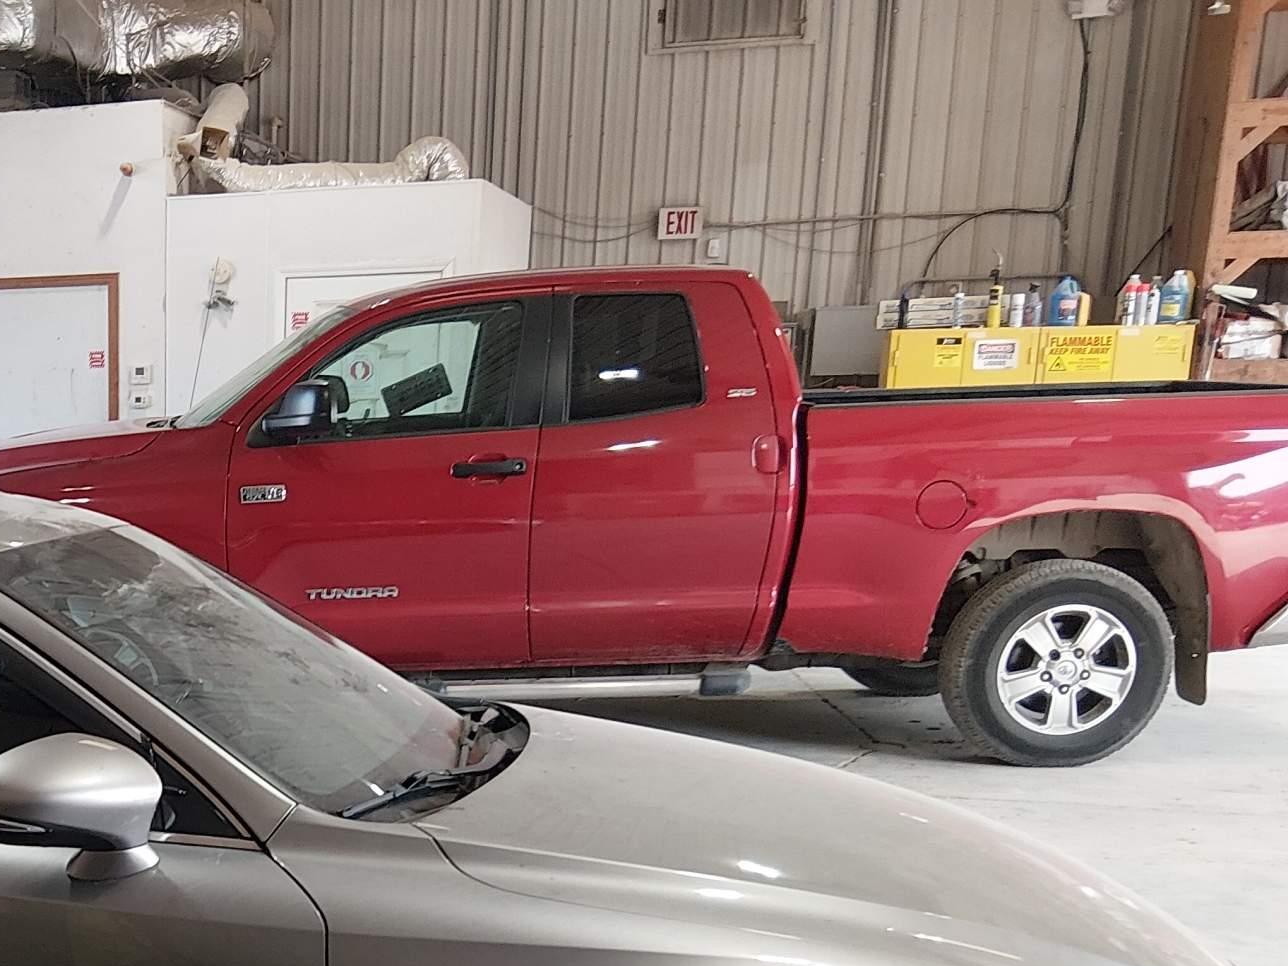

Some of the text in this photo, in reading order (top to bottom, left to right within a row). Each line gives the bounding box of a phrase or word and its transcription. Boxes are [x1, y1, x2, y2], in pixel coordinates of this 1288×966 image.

[666, 211, 697, 235] EXIT
[1050, 336, 1112, 347] FLAMMABLE
[305, 586, 399, 600] TUNDRA
